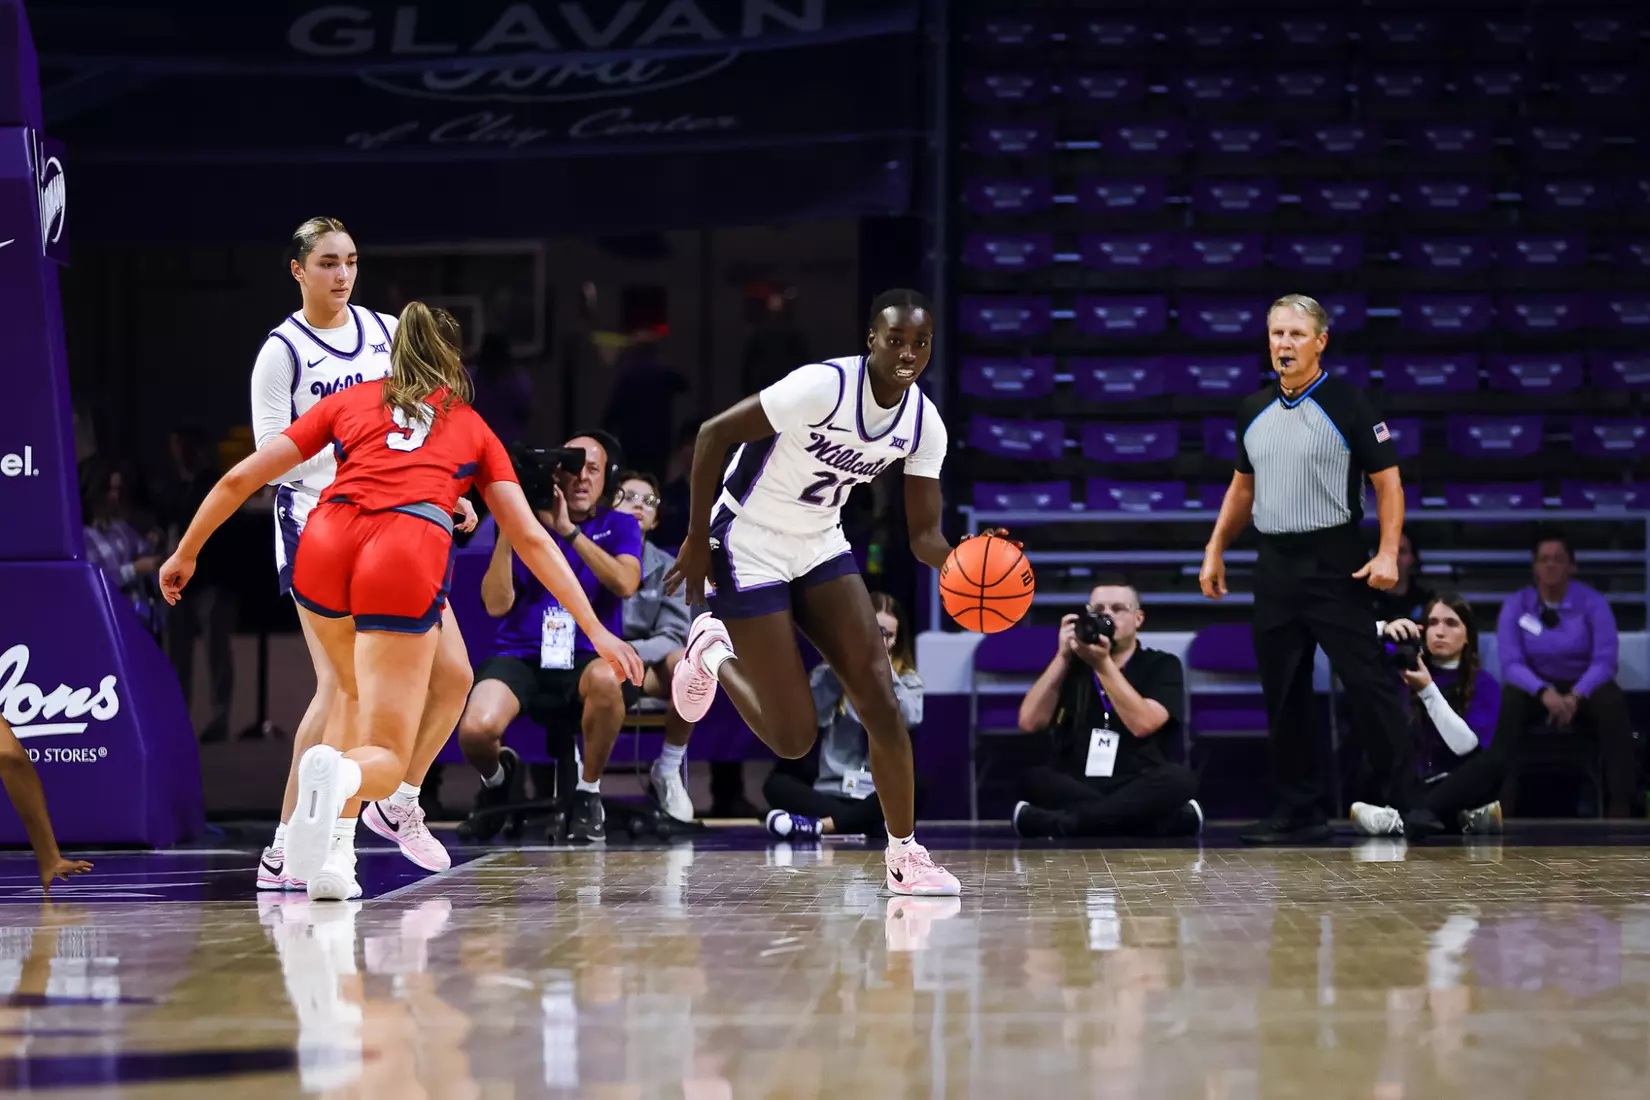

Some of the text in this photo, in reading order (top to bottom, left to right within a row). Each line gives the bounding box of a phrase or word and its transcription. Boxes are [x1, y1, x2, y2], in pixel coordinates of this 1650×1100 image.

[287, 0, 826, 56] GLAVAN
[428, 110, 549, 149] Clay
[798, 471, 858, 508] 21
